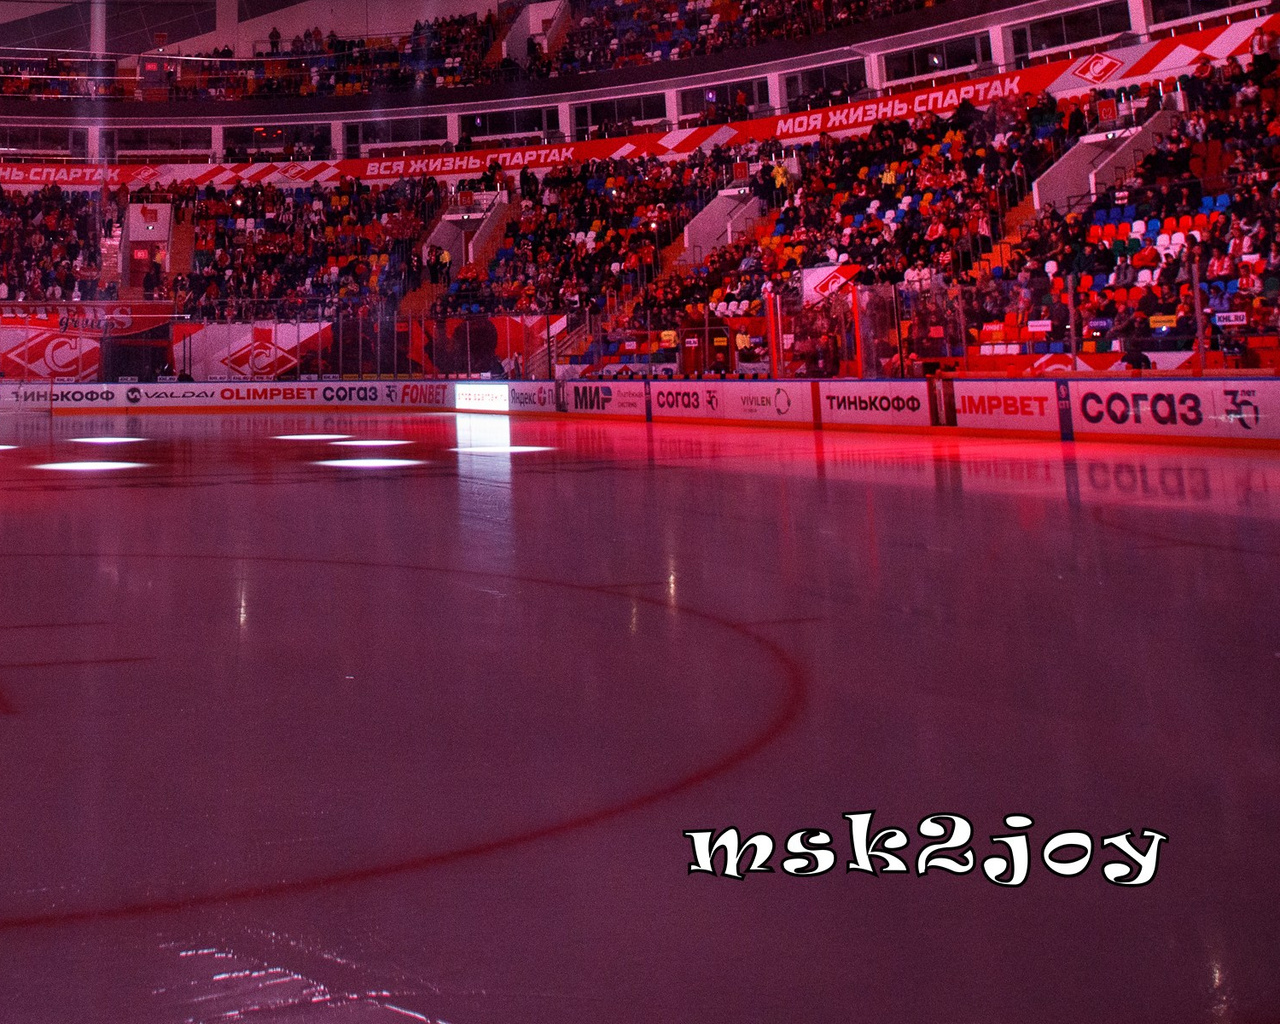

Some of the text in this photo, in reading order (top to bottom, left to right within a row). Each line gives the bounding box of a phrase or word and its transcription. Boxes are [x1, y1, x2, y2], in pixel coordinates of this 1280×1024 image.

[776, 112, 821, 136] МОЯ
[366, 161, 405, 176] ВСЯ
[11, 389, 115, 402] ТИНЬКОФФ
[144, 391, 215, 399] VALDAI
[220, 388, 318, 401] OLIMPBET
[400, 384, 447, 404] FONBET
[511, 388, 536, 406] Яндекс
[574, 385, 612, 410] МИР
[741, 395, 771, 407] VIVILEN
[826, 395, 921, 413] ТИНЬКОФФ
[956, 395, 1048, 416] IMPBET
